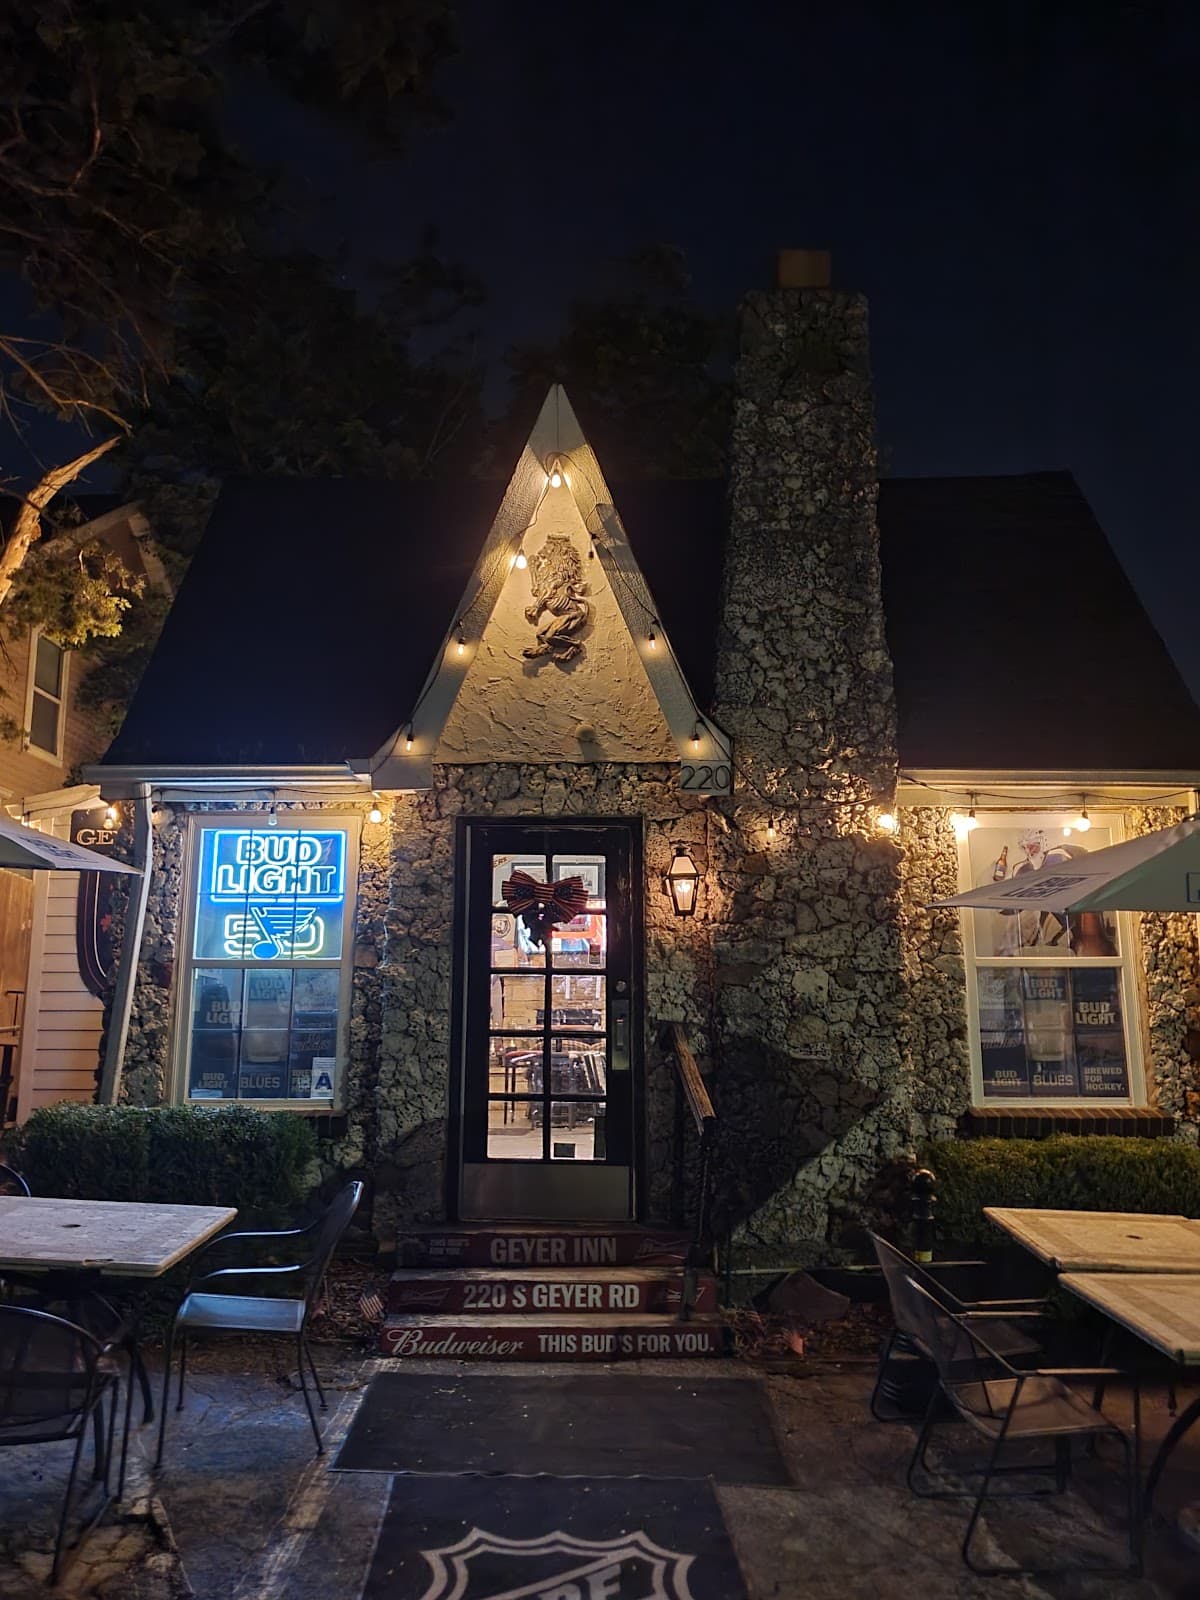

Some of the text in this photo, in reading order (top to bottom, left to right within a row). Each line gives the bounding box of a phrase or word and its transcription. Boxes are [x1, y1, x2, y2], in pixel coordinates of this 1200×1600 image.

[680, 765, 732, 790] 220
[236, 836, 322, 865] BUD
[217, 864, 337, 894] LIGHT
[1031, 978, 1059, 988] BUD
[1027, 988, 1064, 999] LIGHT
[1079, 1002, 1110, 1013] BUD
[1076, 1012, 1116, 1025] LIGHT
[995, 1070, 1018, 1078] BUD
[1084, 1067, 1122, 1075] BREWED
[240, 1076, 281, 1089] BLUES
[315, 1072, 333, 1090] A
[991, 1077, 1022, 1087] LIGHT
[1033, 1074, 1074, 1086] BLUES
[1085, 1075, 1103, 1083] FOR
[1085, 1082, 1125, 1091] HOCKEY.
[490, 1238, 566, 1264] GEYER
[573, 1237, 617, 1262] INN
[463, 1284, 640, 1309] 220 S GEYER RD
[386, 1329, 524, 1356] Budweiser
[538, 1334, 577, 1353] THIS
[637, 1334, 671, 1353] FOR
[674, 1333, 715, 1353] YOU.
